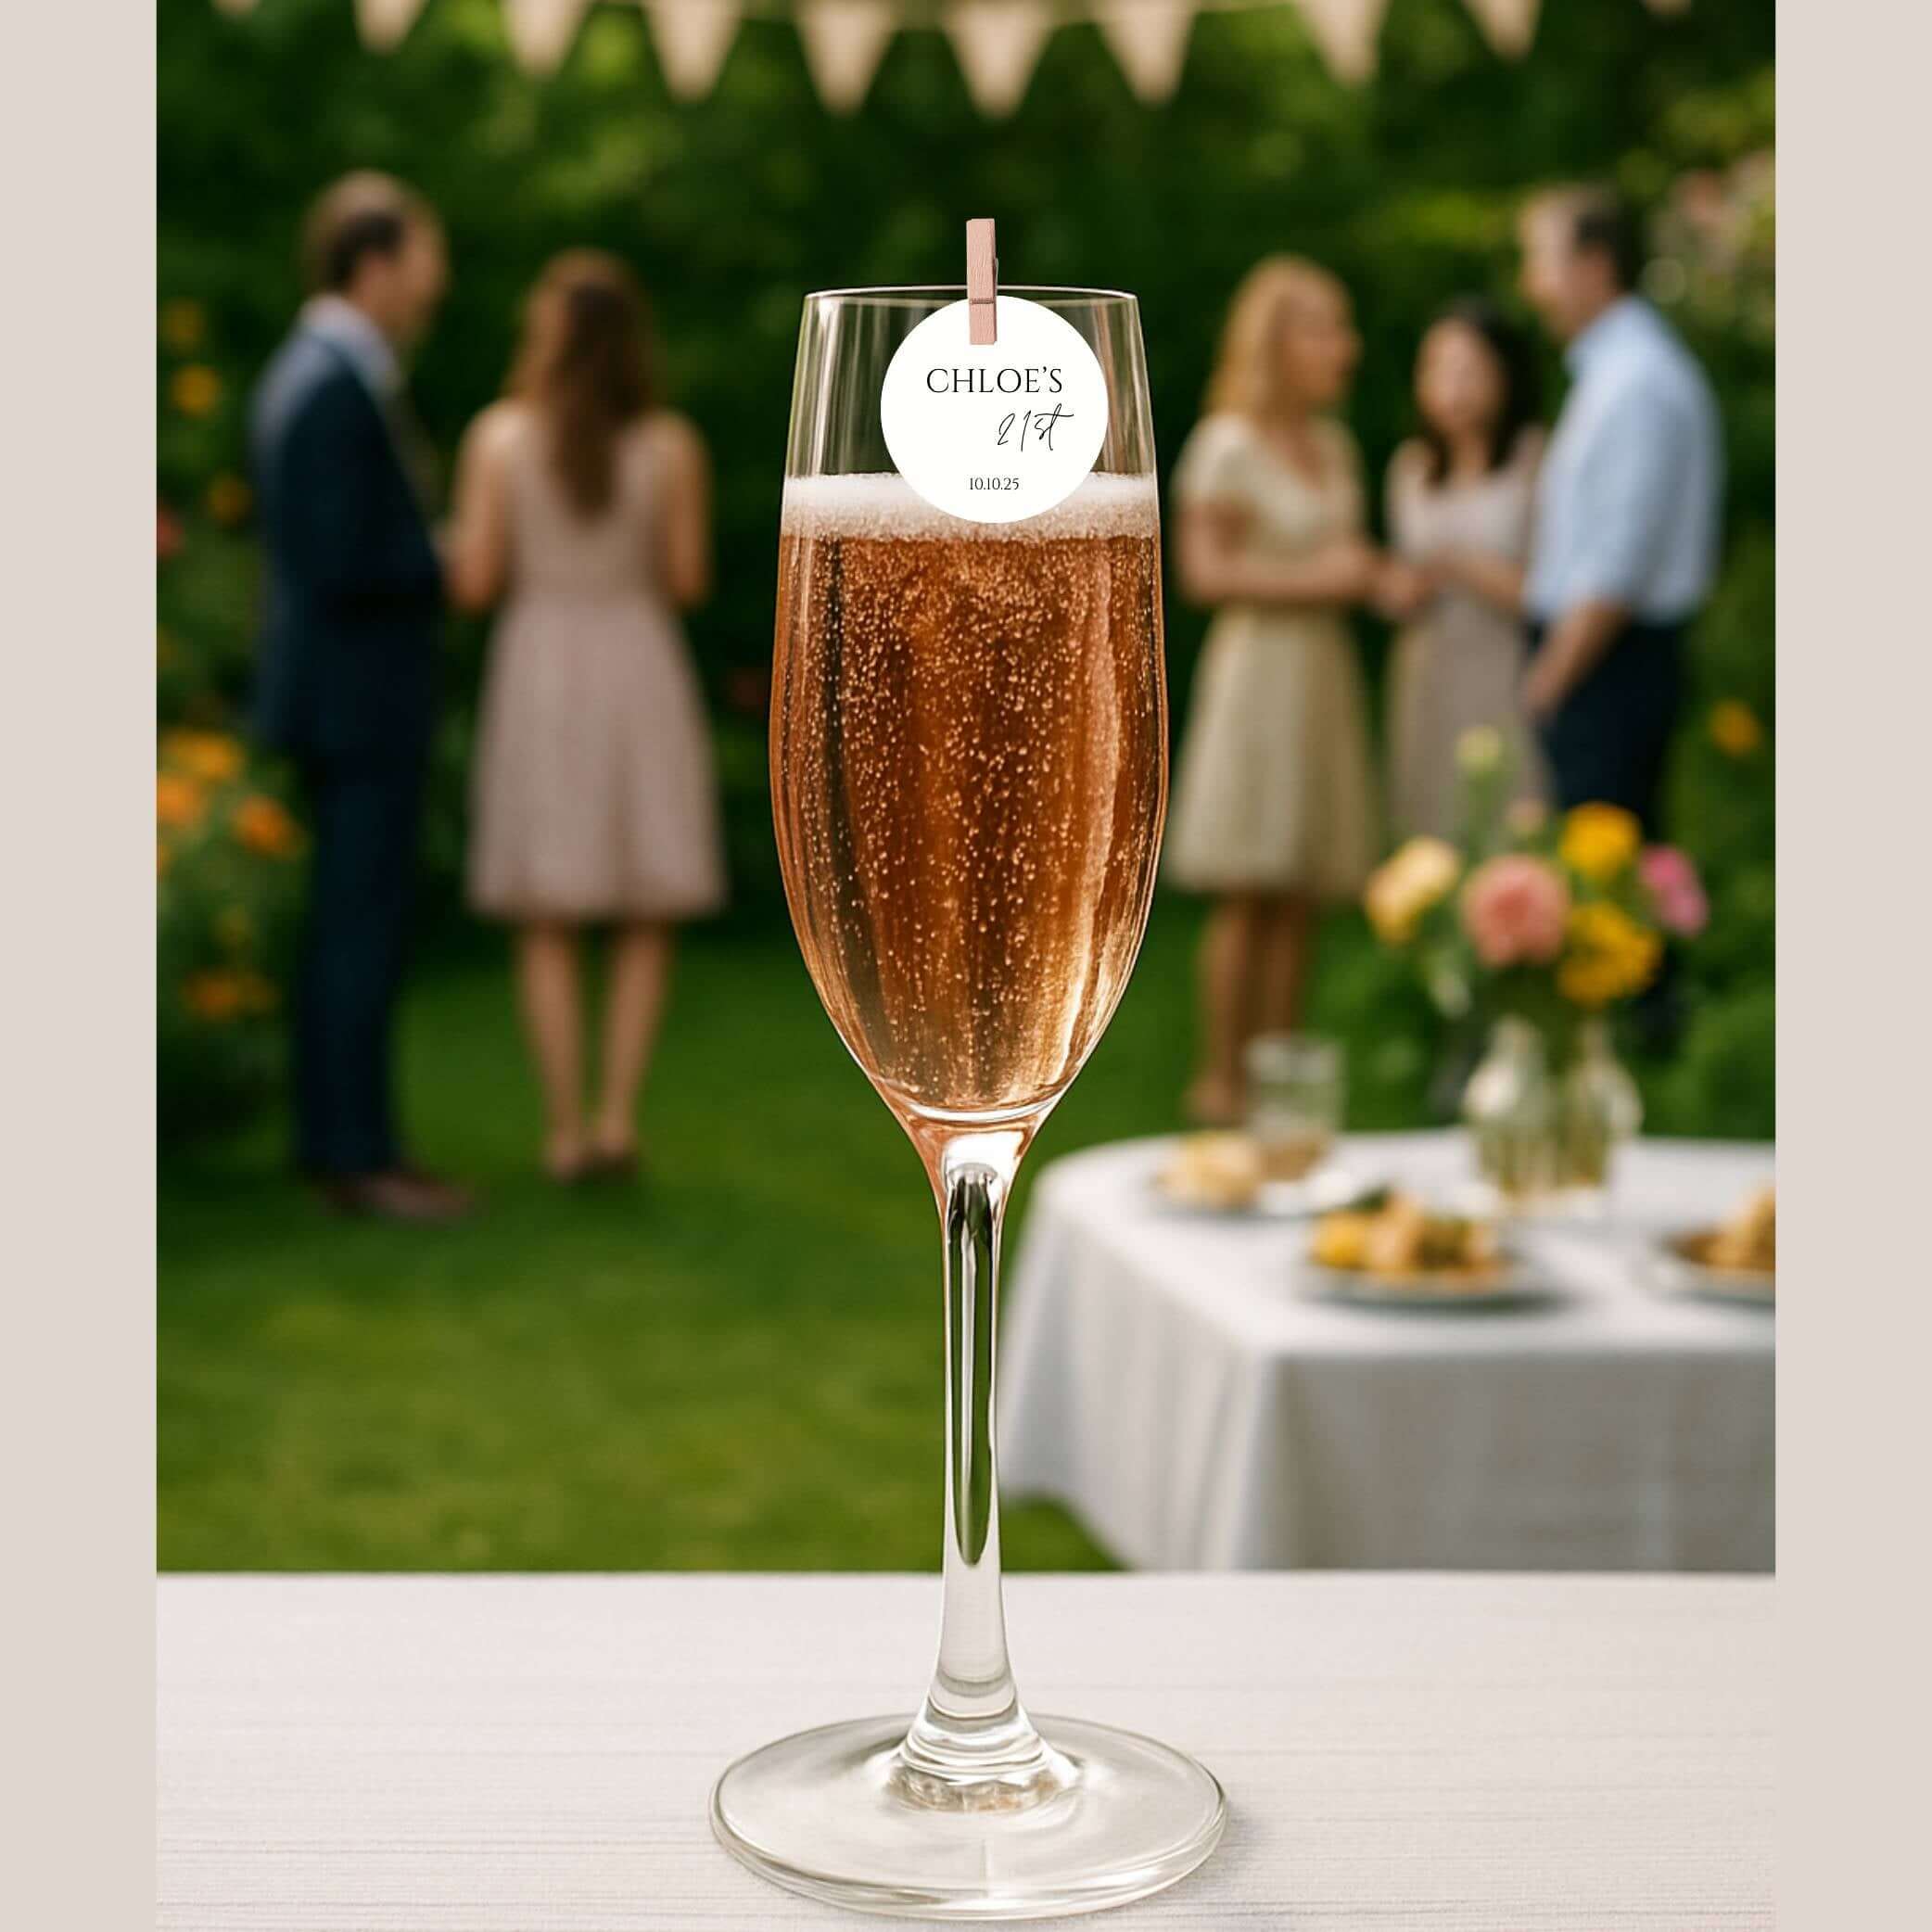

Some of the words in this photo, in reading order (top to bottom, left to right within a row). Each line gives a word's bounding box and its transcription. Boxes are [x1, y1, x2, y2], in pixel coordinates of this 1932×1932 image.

[926, 365, 1062, 394] CHLOE’S
[997, 402, 1074, 452] 21st
[969, 477, 1020, 490] 10.10.25
